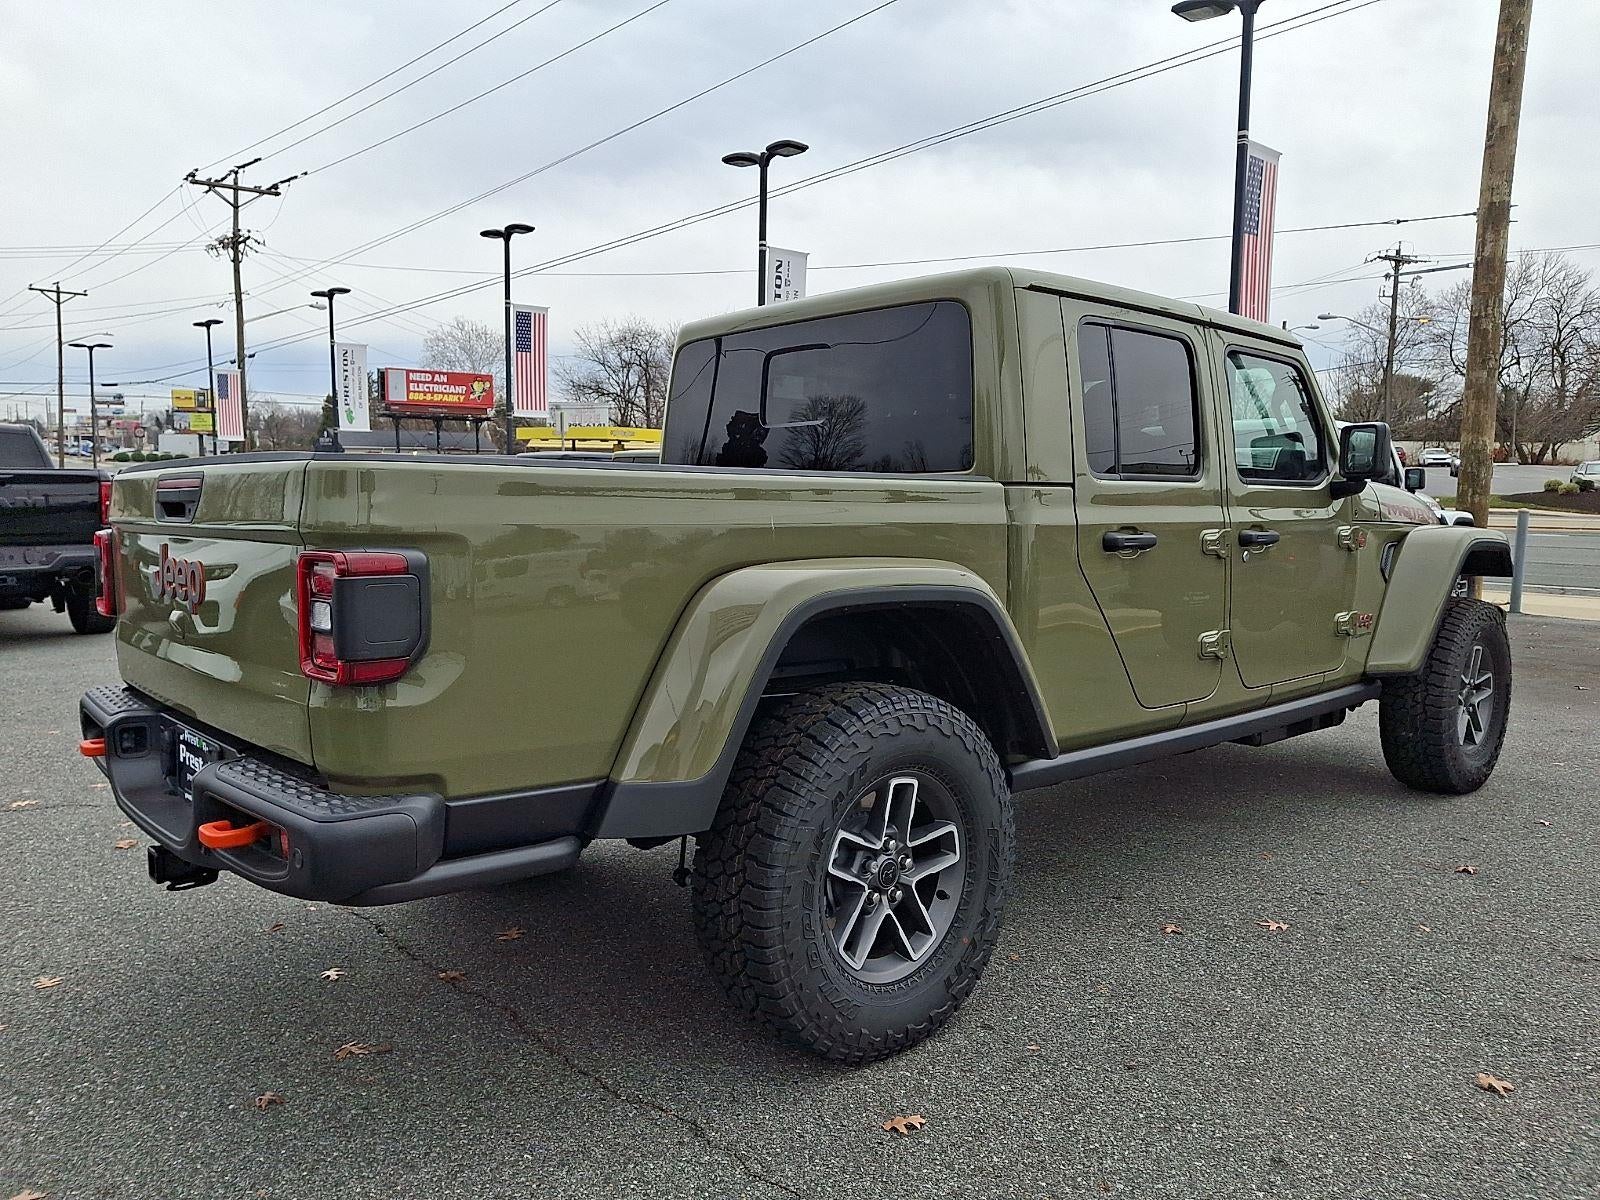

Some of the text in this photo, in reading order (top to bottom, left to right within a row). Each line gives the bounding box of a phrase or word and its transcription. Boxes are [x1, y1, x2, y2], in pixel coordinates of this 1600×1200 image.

[342, 348, 350, 406] PRESTON
[409, 372, 448, 383] NEED AN
[409, 382, 467, 394] ELECTRICIAN?
[153, 543, 205, 614] Jeep
